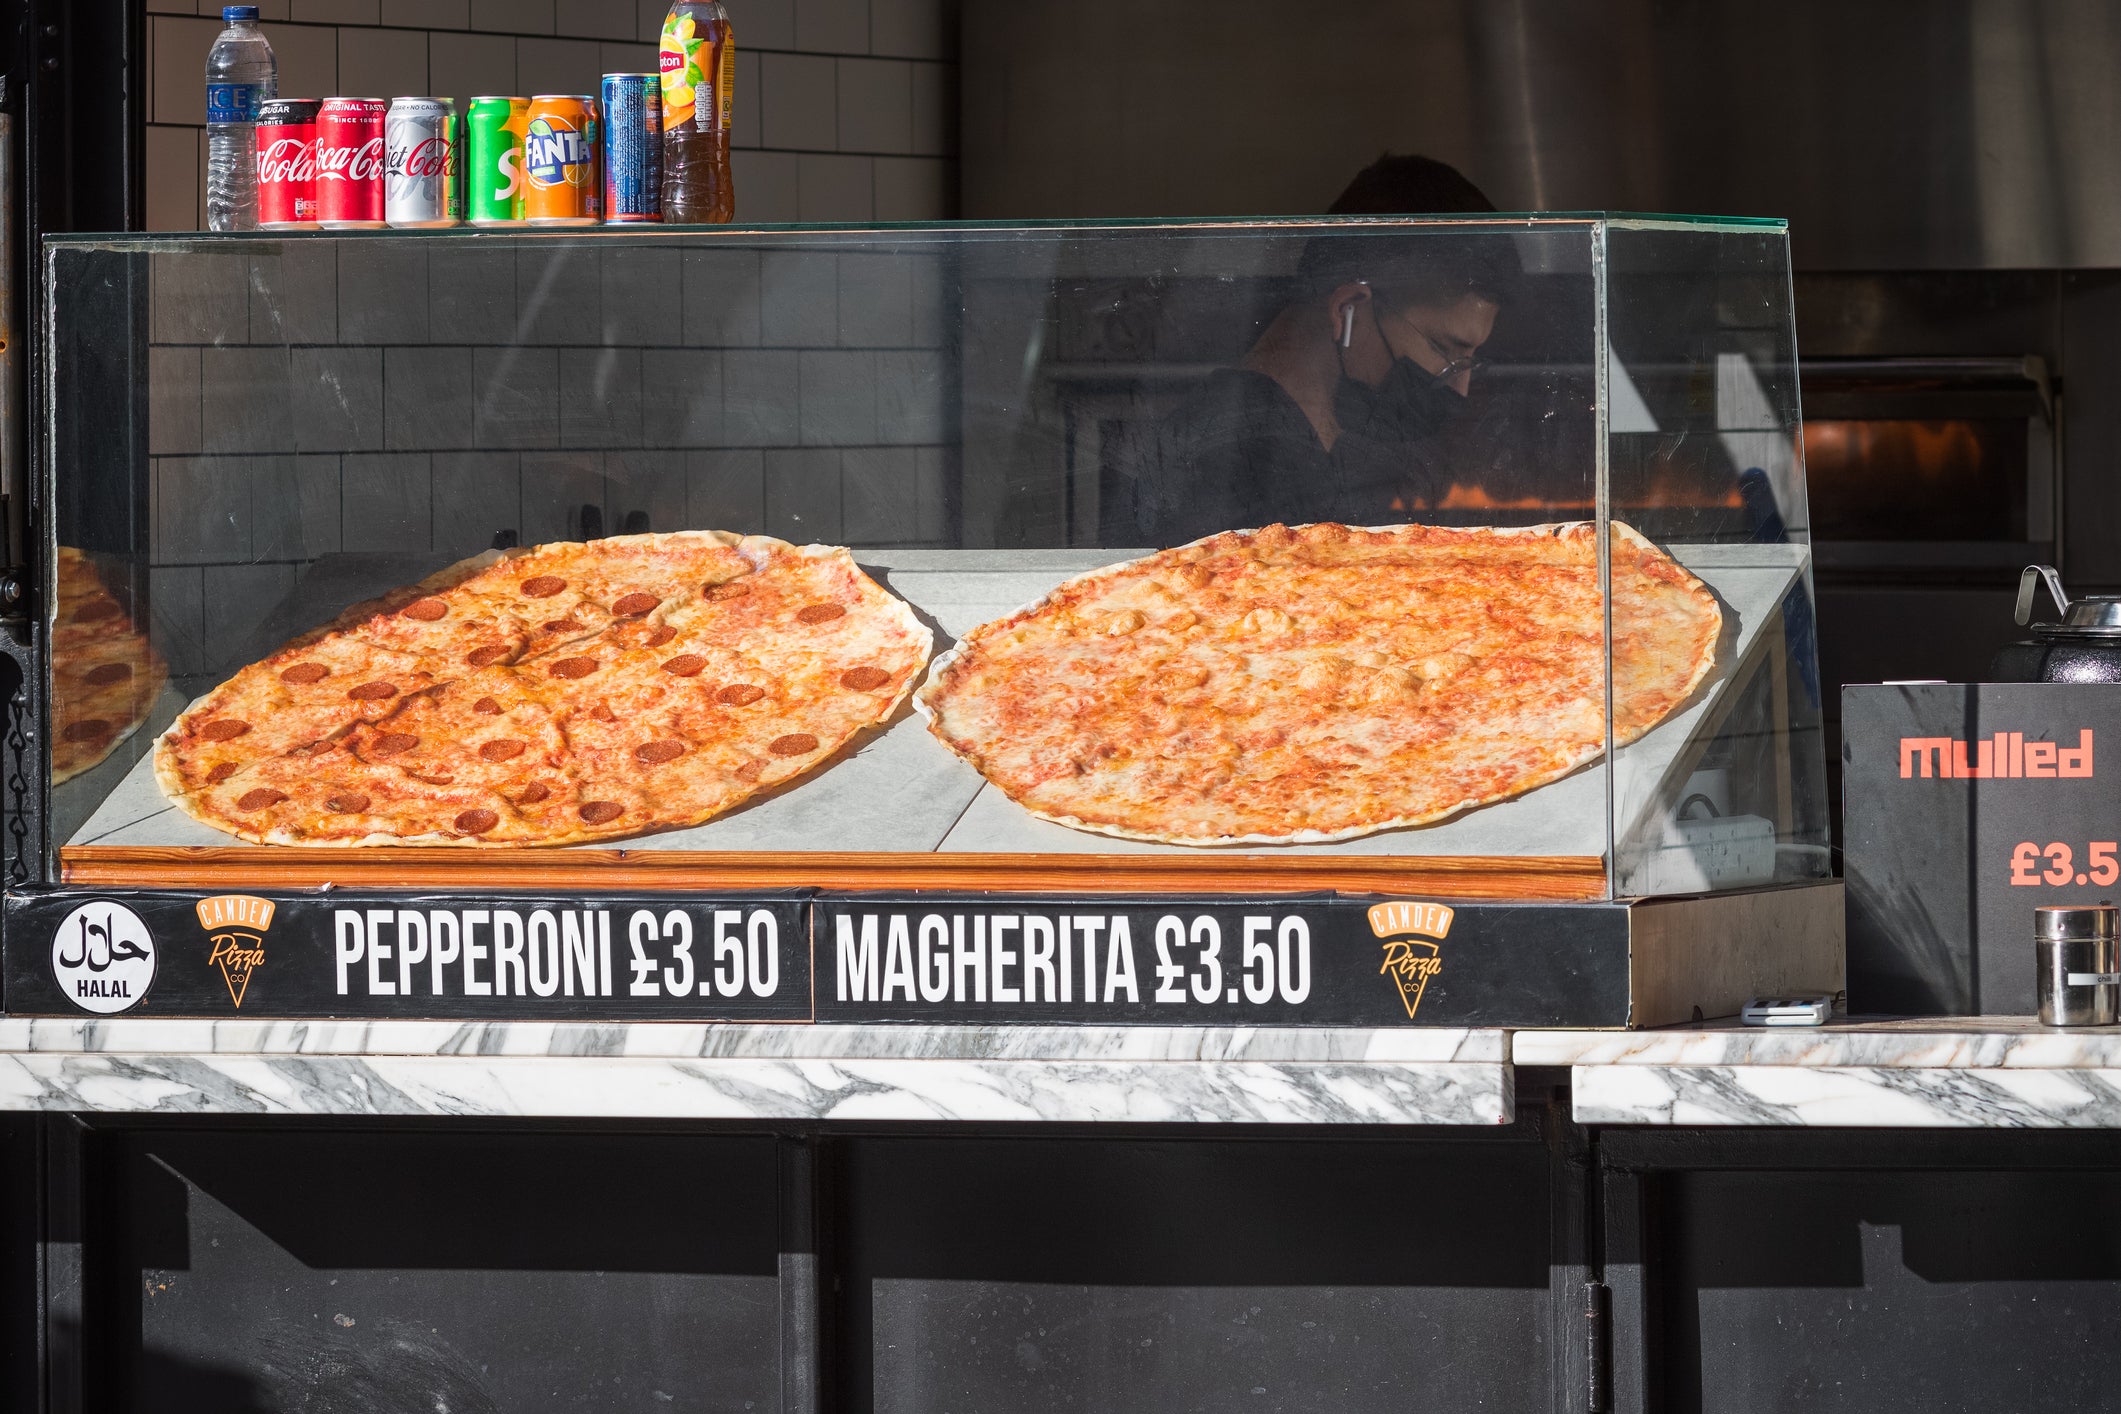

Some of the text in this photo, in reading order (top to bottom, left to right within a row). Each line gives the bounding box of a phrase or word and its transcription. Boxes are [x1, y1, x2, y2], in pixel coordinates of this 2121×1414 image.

[209, 88, 247, 109] ICE
[324, 104, 361, 112] ORIGINAL
[406, 137, 458, 177] Coke
[526, 131, 591, 169] FANTA
[200, 899, 271, 927] CAMDEN
[1372, 905, 1449, 934] CAMDEN
[59, 912, 151, 973] حلال
[208, 934, 265, 971] Pizza
[334, 909, 779, 998] PEPPERONI £3.50
[835, 913, 1311, 1005] MAGHERITA £3.50
[230, 973, 245, 983] CO
[1380, 942, 1442, 981] Pizza
[77, 979, 132, 998] HALAL
[1403, 983, 1420, 992] CO
